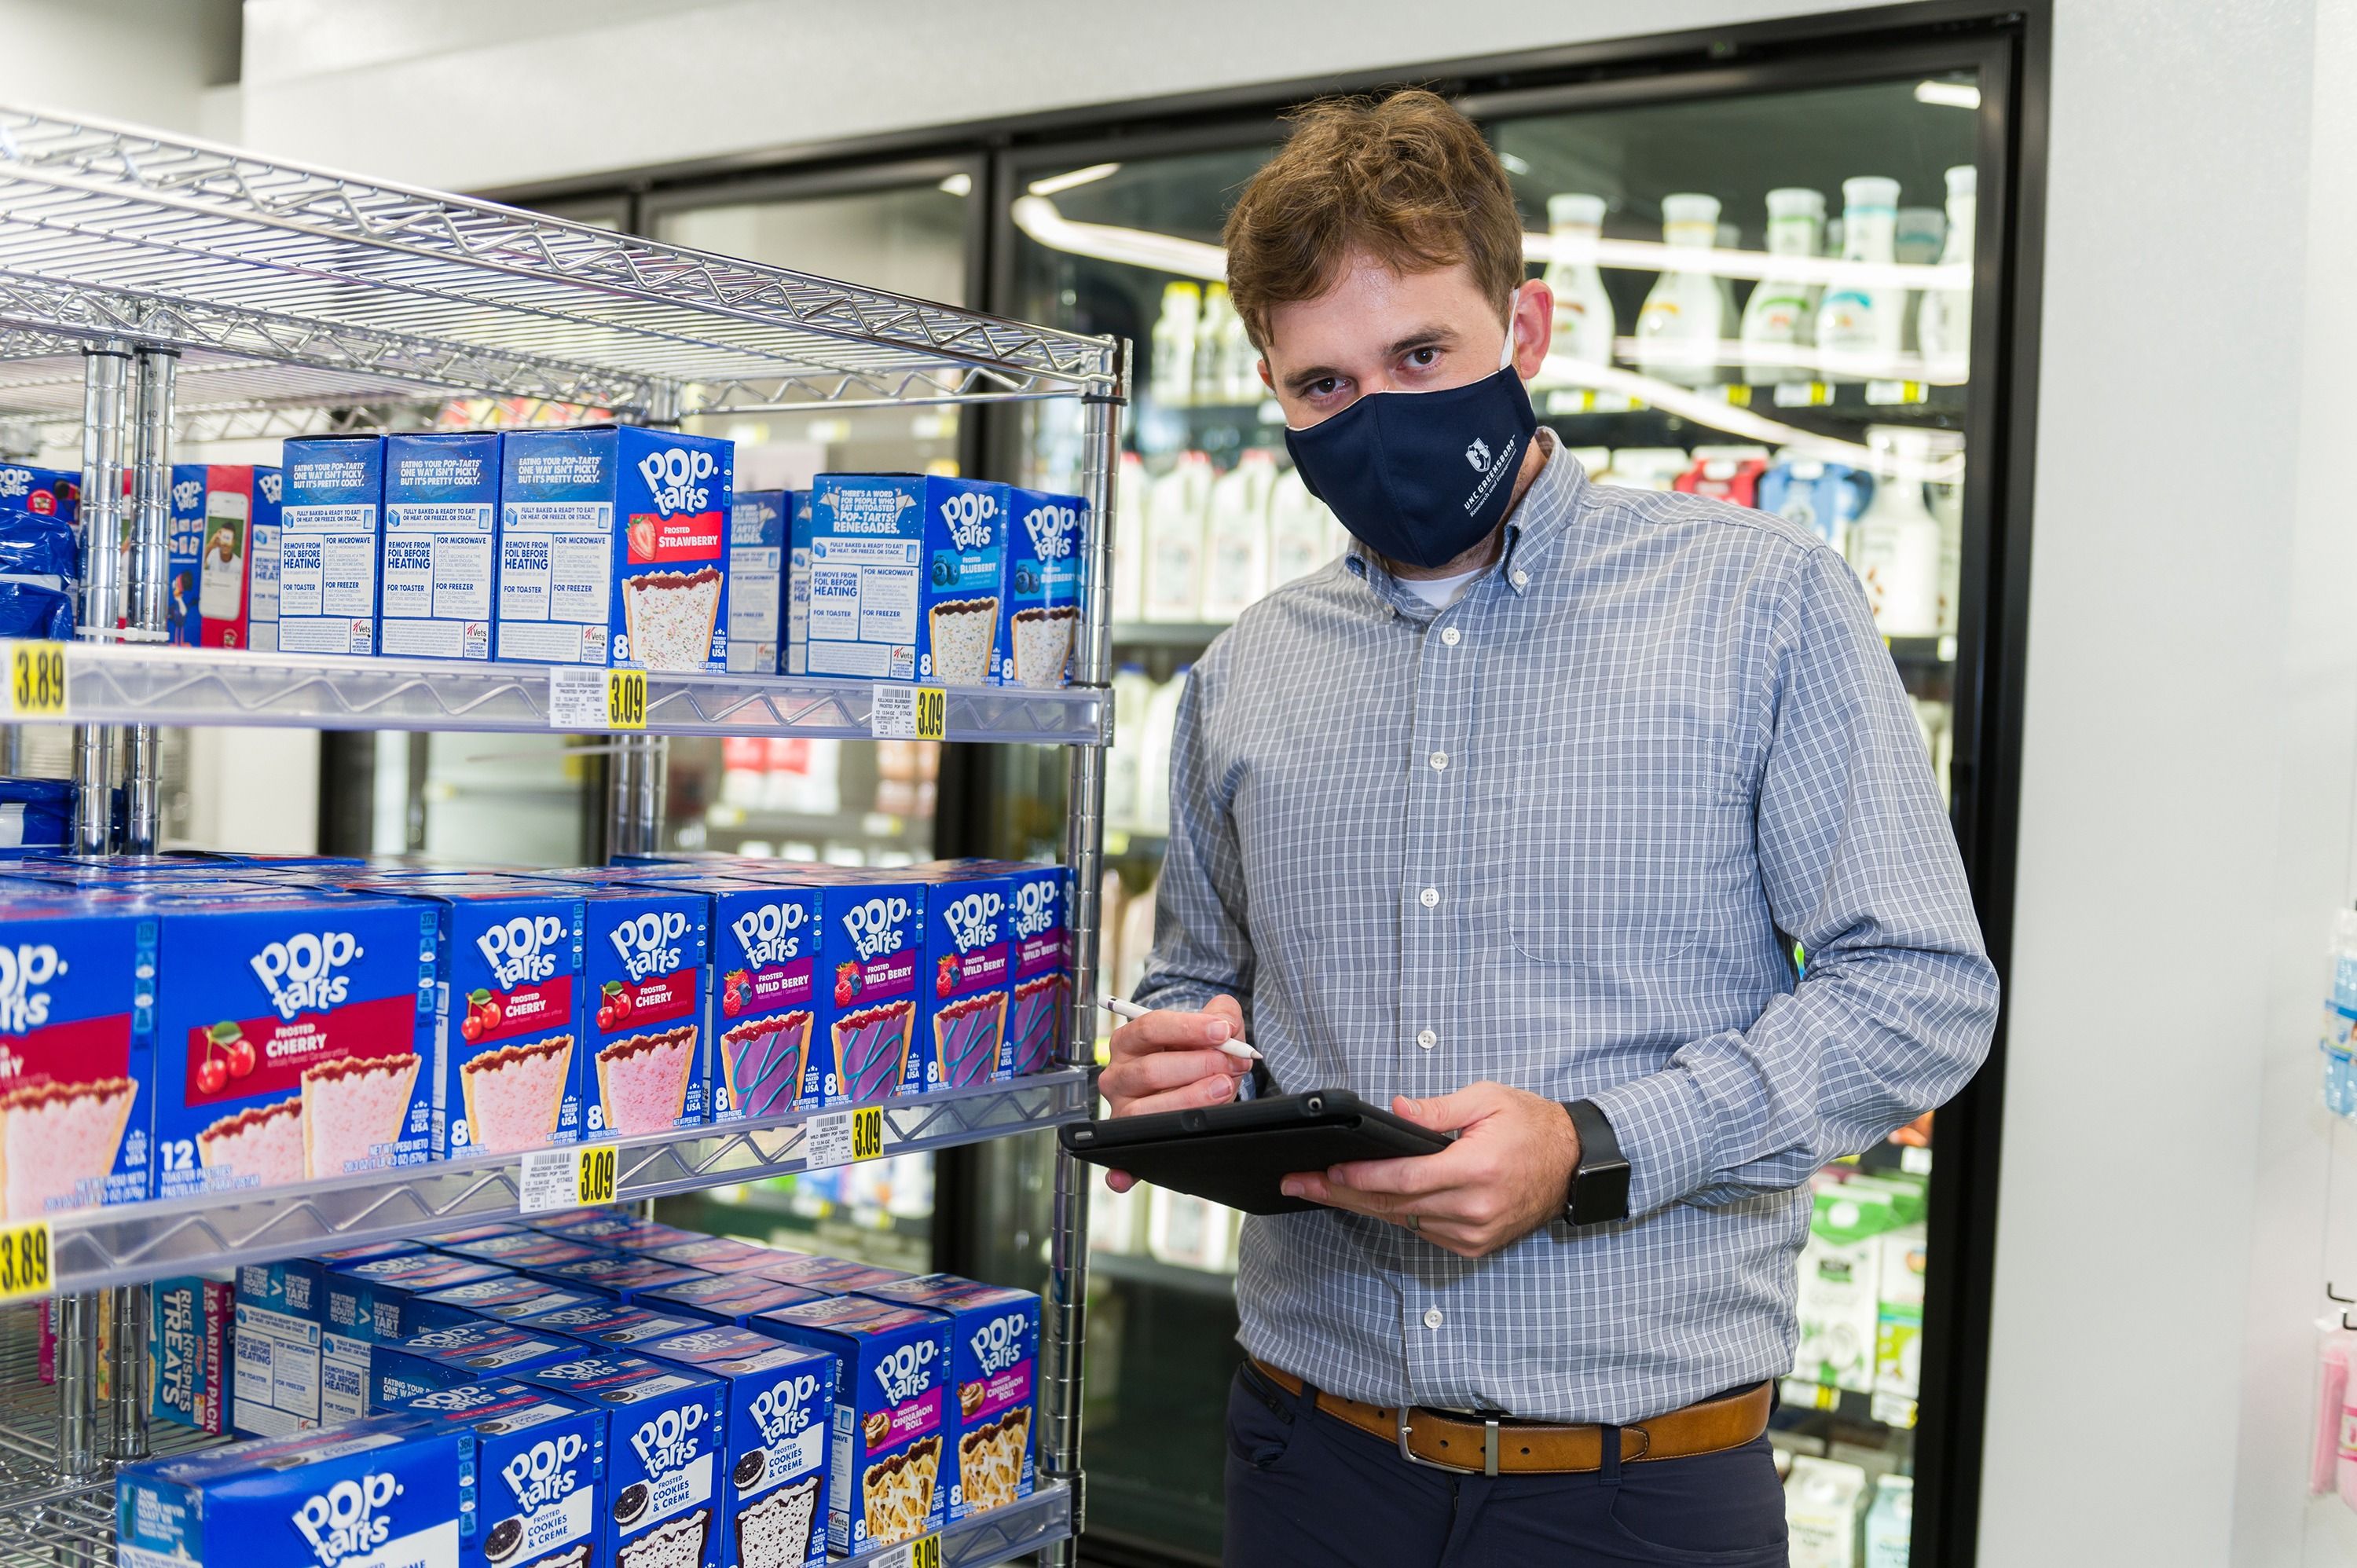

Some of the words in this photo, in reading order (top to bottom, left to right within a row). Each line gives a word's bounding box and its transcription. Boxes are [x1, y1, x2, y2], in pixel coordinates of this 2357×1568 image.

[532, 474, 545, 483] IT'S
[546, 474, 572, 483] PRETTY
[554, 465, 572, 474] ISN'T
[1464, 492, 1479, 510] UNC
[1478, 439, 1515, 493] GREENSBORO
[1469, 492, 1490, 518] Research
[1489, 480, 1498, 494] and
[834, 522, 900, 534] RENEGADES.
[658, 535, 718, 548] STRAWBERRY
[522, 549, 548, 558] BEFORE
[505, 559, 548, 570] HEATING
[960, 562, 996, 574] BLUEBERRY
[613, 635, 629, 660] 8
[712, 648, 726, 658] USA
[920, 654, 931, 676] 8
[1003, 658, 1014, 680] 8
[18, 650, 63, 707] 3.89
[610, 674, 643, 723] 3.09
[918, 692, 943, 735] 3.09
[965, 955, 985, 965] FROSTED
[1023, 948, 1041, 962] WILD
[865, 973, 886, 985] WILD
[889, 965, 912, 980] BERRY
[867, 963, 889, 973] FROSTED
[962, 965, 982, 976] WILD
[983, 958, 1006, 971] BERRY
[755, 982, 779, 995] WILD
[782, 974, 809, 989] BERRY
[758, 971, 783, 982] FROSTED
[511, 992, 540, 1005] FROSTED
[640, 984, 666, 996] FROSTED
[635, 991, 673, 1009] CHERRY
[504, 1001, 546, 1019] CHERRY
[276, 1023, 316, 1039] FROSTED
[266, 1033, 327, 1058] CHERRY
[907, 1071, 919, 1079] USA
[927, 1061, 938, 1083] 8
[824, 1073, 837, 1096] 8
[687, 1101, 701, 1112] USA
[716, 1087, 728, 1111] 8
[561, 1116, 577, 1127] USA
[587, 1105, 603, 1130] 8
[410, 1123, 429, 1133] USA
[451, 1119, 469, 1147] 8
[855, 1111, 881, 1157] 3.09
[160, 1139, 194, 1170] 12
[581, 1151, 614, 1201] 3.09
[2, 1228, 47, 1291] 3.89
[207, 1288, 220, 1313] 16
[180, 1289, 192, 1331] RICE
[163, 1292, 182, 1405] TREATS
[207, 1317, 219, 1384] VARIETY
[179, 1333, 192, 1412] KRISPIES
[991, 1376, 1010, 1387] FROSTED
[383, 1385, 398, 1395] ONE
[384, 1377, 406, 1389] EATING
[407, 1381, 425, 1393] YOUR
[987, 1376, 1024, 1398] CINNAMON
[999, 1389, 1014, 1401] ROLL
[206, 1388, 219, 1432] PACK
[893, 1405, 933, 1429] CINNAMON
[898, 1404, 918, 1417] FROSTED
[905, 1420, 923, 1431] ROLL
[768, 1449, 803, 1467] COOKIES
[774, 1442, 797, 1456] FROSTED
[658, 1475, 683, 1489] FROSTED
[768, 1470, 775, 1478] &
[653, 1480, 690, 1500] COOKIES
[950, 1485, 962, 1507] 8
[533, 1509, 560, 1524] FROSTED
[653, 1504, 660, 1512] &
[528, 1515, 567, 1537] COOKIES
[854, 1519, 866, 1541] 8
[528, 1540, 535, 1548] &
[812, 1546, 825, 1555] USA
